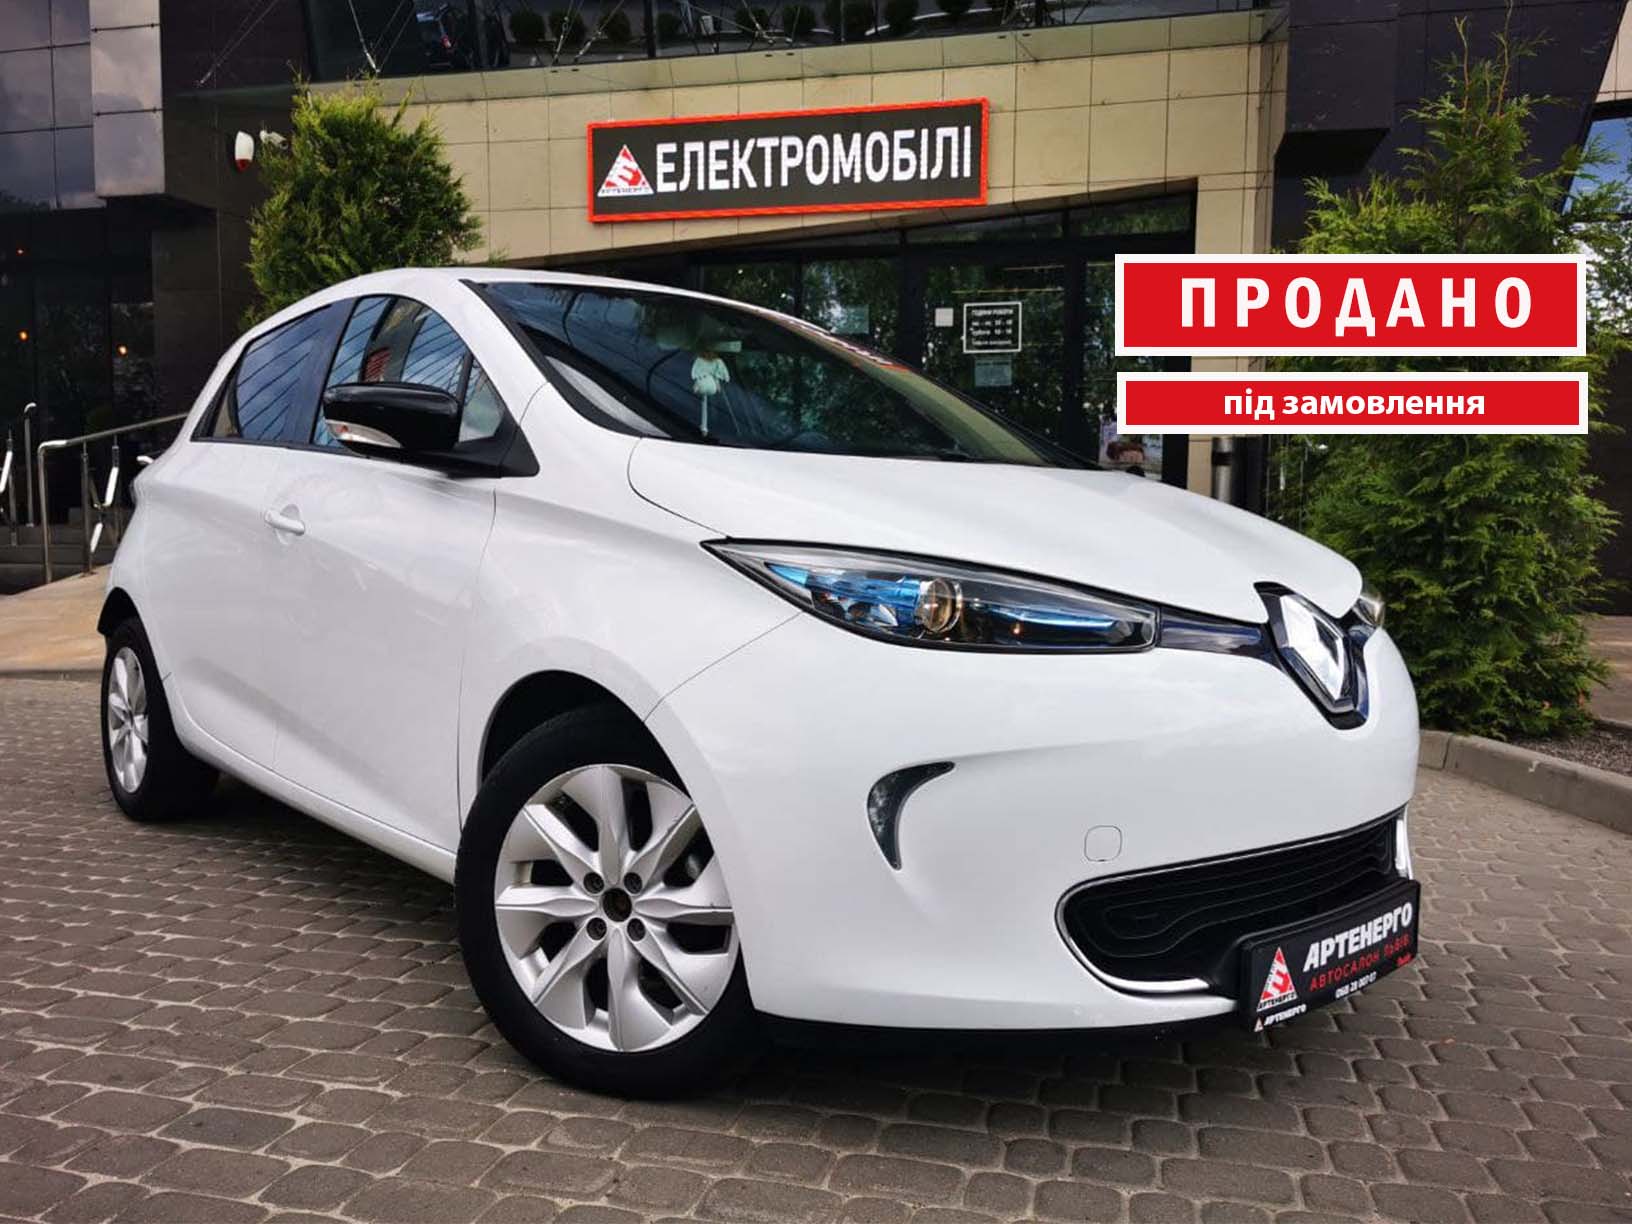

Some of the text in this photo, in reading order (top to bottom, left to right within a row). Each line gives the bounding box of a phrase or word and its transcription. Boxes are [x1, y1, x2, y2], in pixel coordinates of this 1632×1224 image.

[656, 125, 972, 193] ЕЛЕКТРОМОБІЛІ
[1302, 902, 1413, 973] АРТЕНЕРГО
[1309, 951, 1380, 992] АВТОСАЛОН
